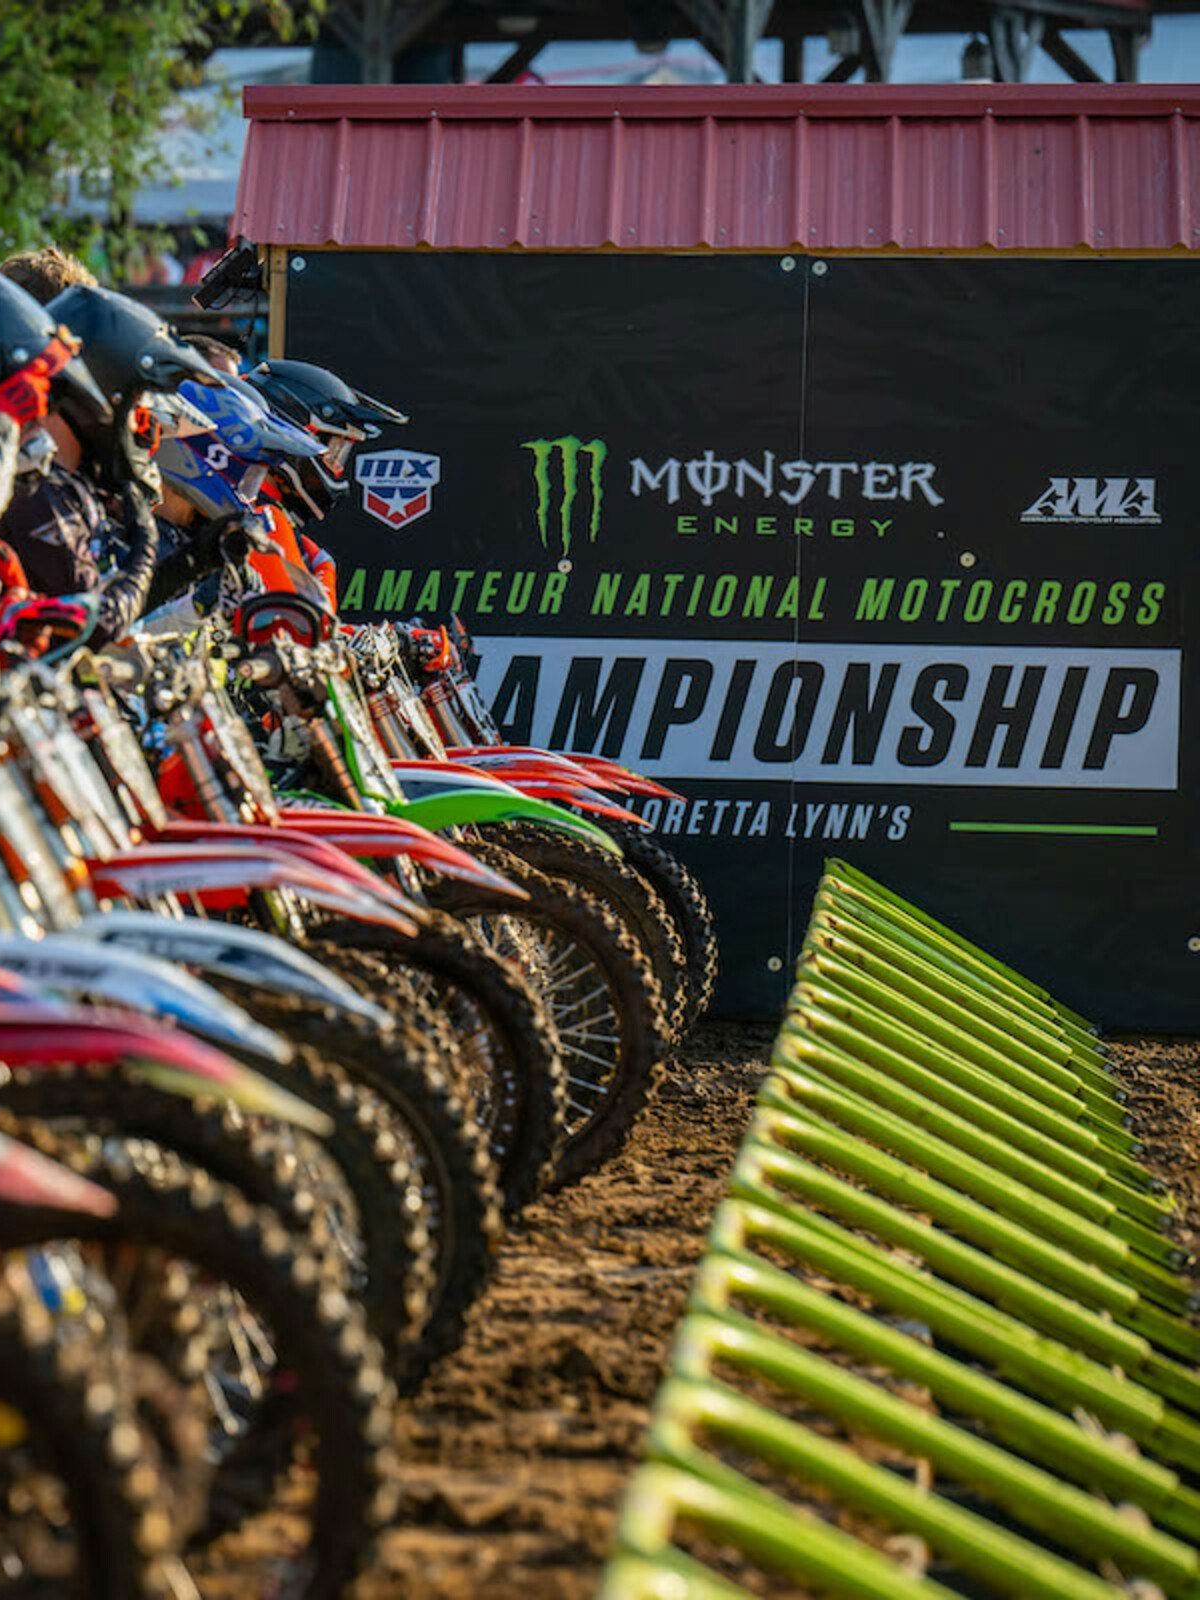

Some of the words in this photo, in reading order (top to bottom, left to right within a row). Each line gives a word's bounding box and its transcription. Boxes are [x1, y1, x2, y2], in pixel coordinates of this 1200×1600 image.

[629, 450, 945, 507] MONSTER
[1021, 477, 1161, 517] AMA
[676, 515, 893, 537] ENERGY
[340, 567, 568, 615] AMATEUR
[590, 572, 828, 620] NATIONAL
[855, 577, 1166, 625] MOTOCROSS
[468, 654, 1160, 770] AMPIONSHIP
[785, 802, 912, 841] LYNN'S
